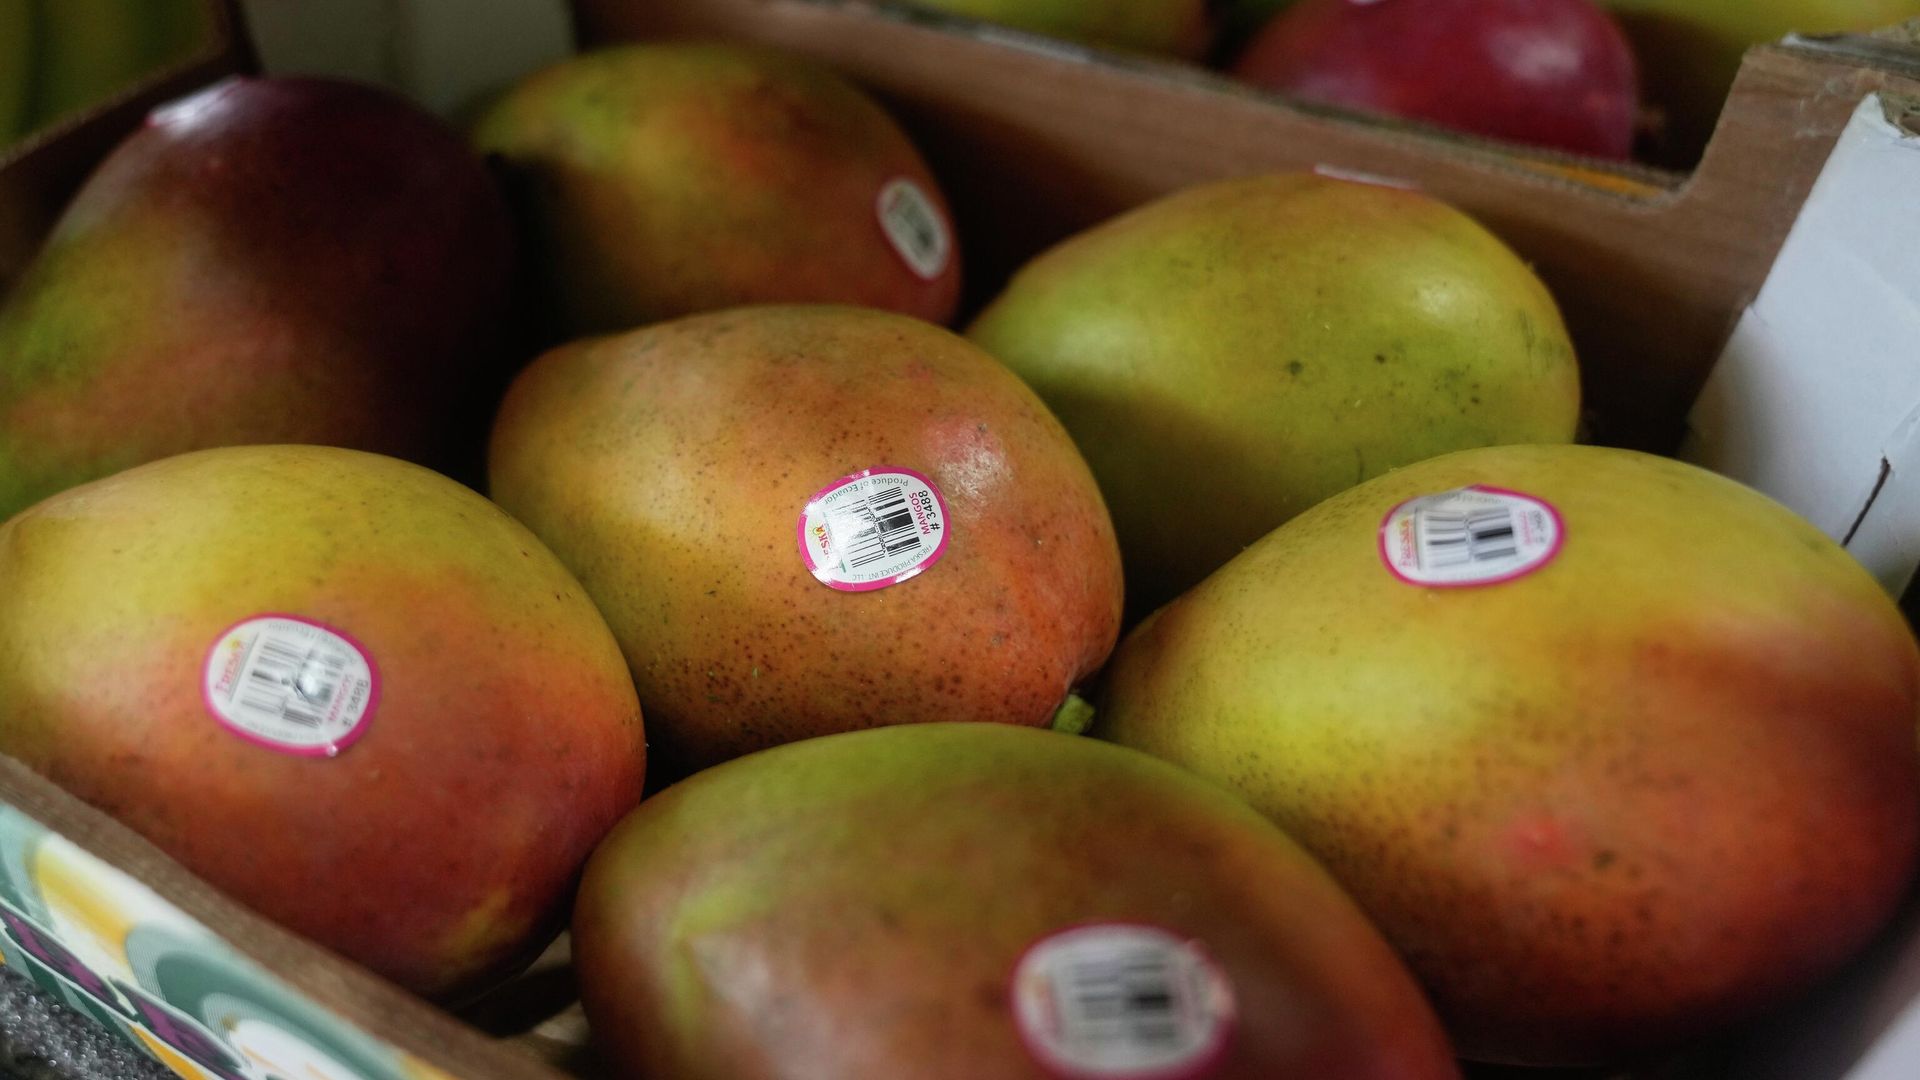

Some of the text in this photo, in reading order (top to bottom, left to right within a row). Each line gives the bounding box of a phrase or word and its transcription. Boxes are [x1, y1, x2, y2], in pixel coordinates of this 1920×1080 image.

[825, 477, 908, 505] Produce of Ecuador
[909, 492, 931, 536] MANGOS
[918, 490, 941, 531] # 3488
[880, 559, 910, 577] PRODUCE
[911, 545, 933, 563] FRESKA
